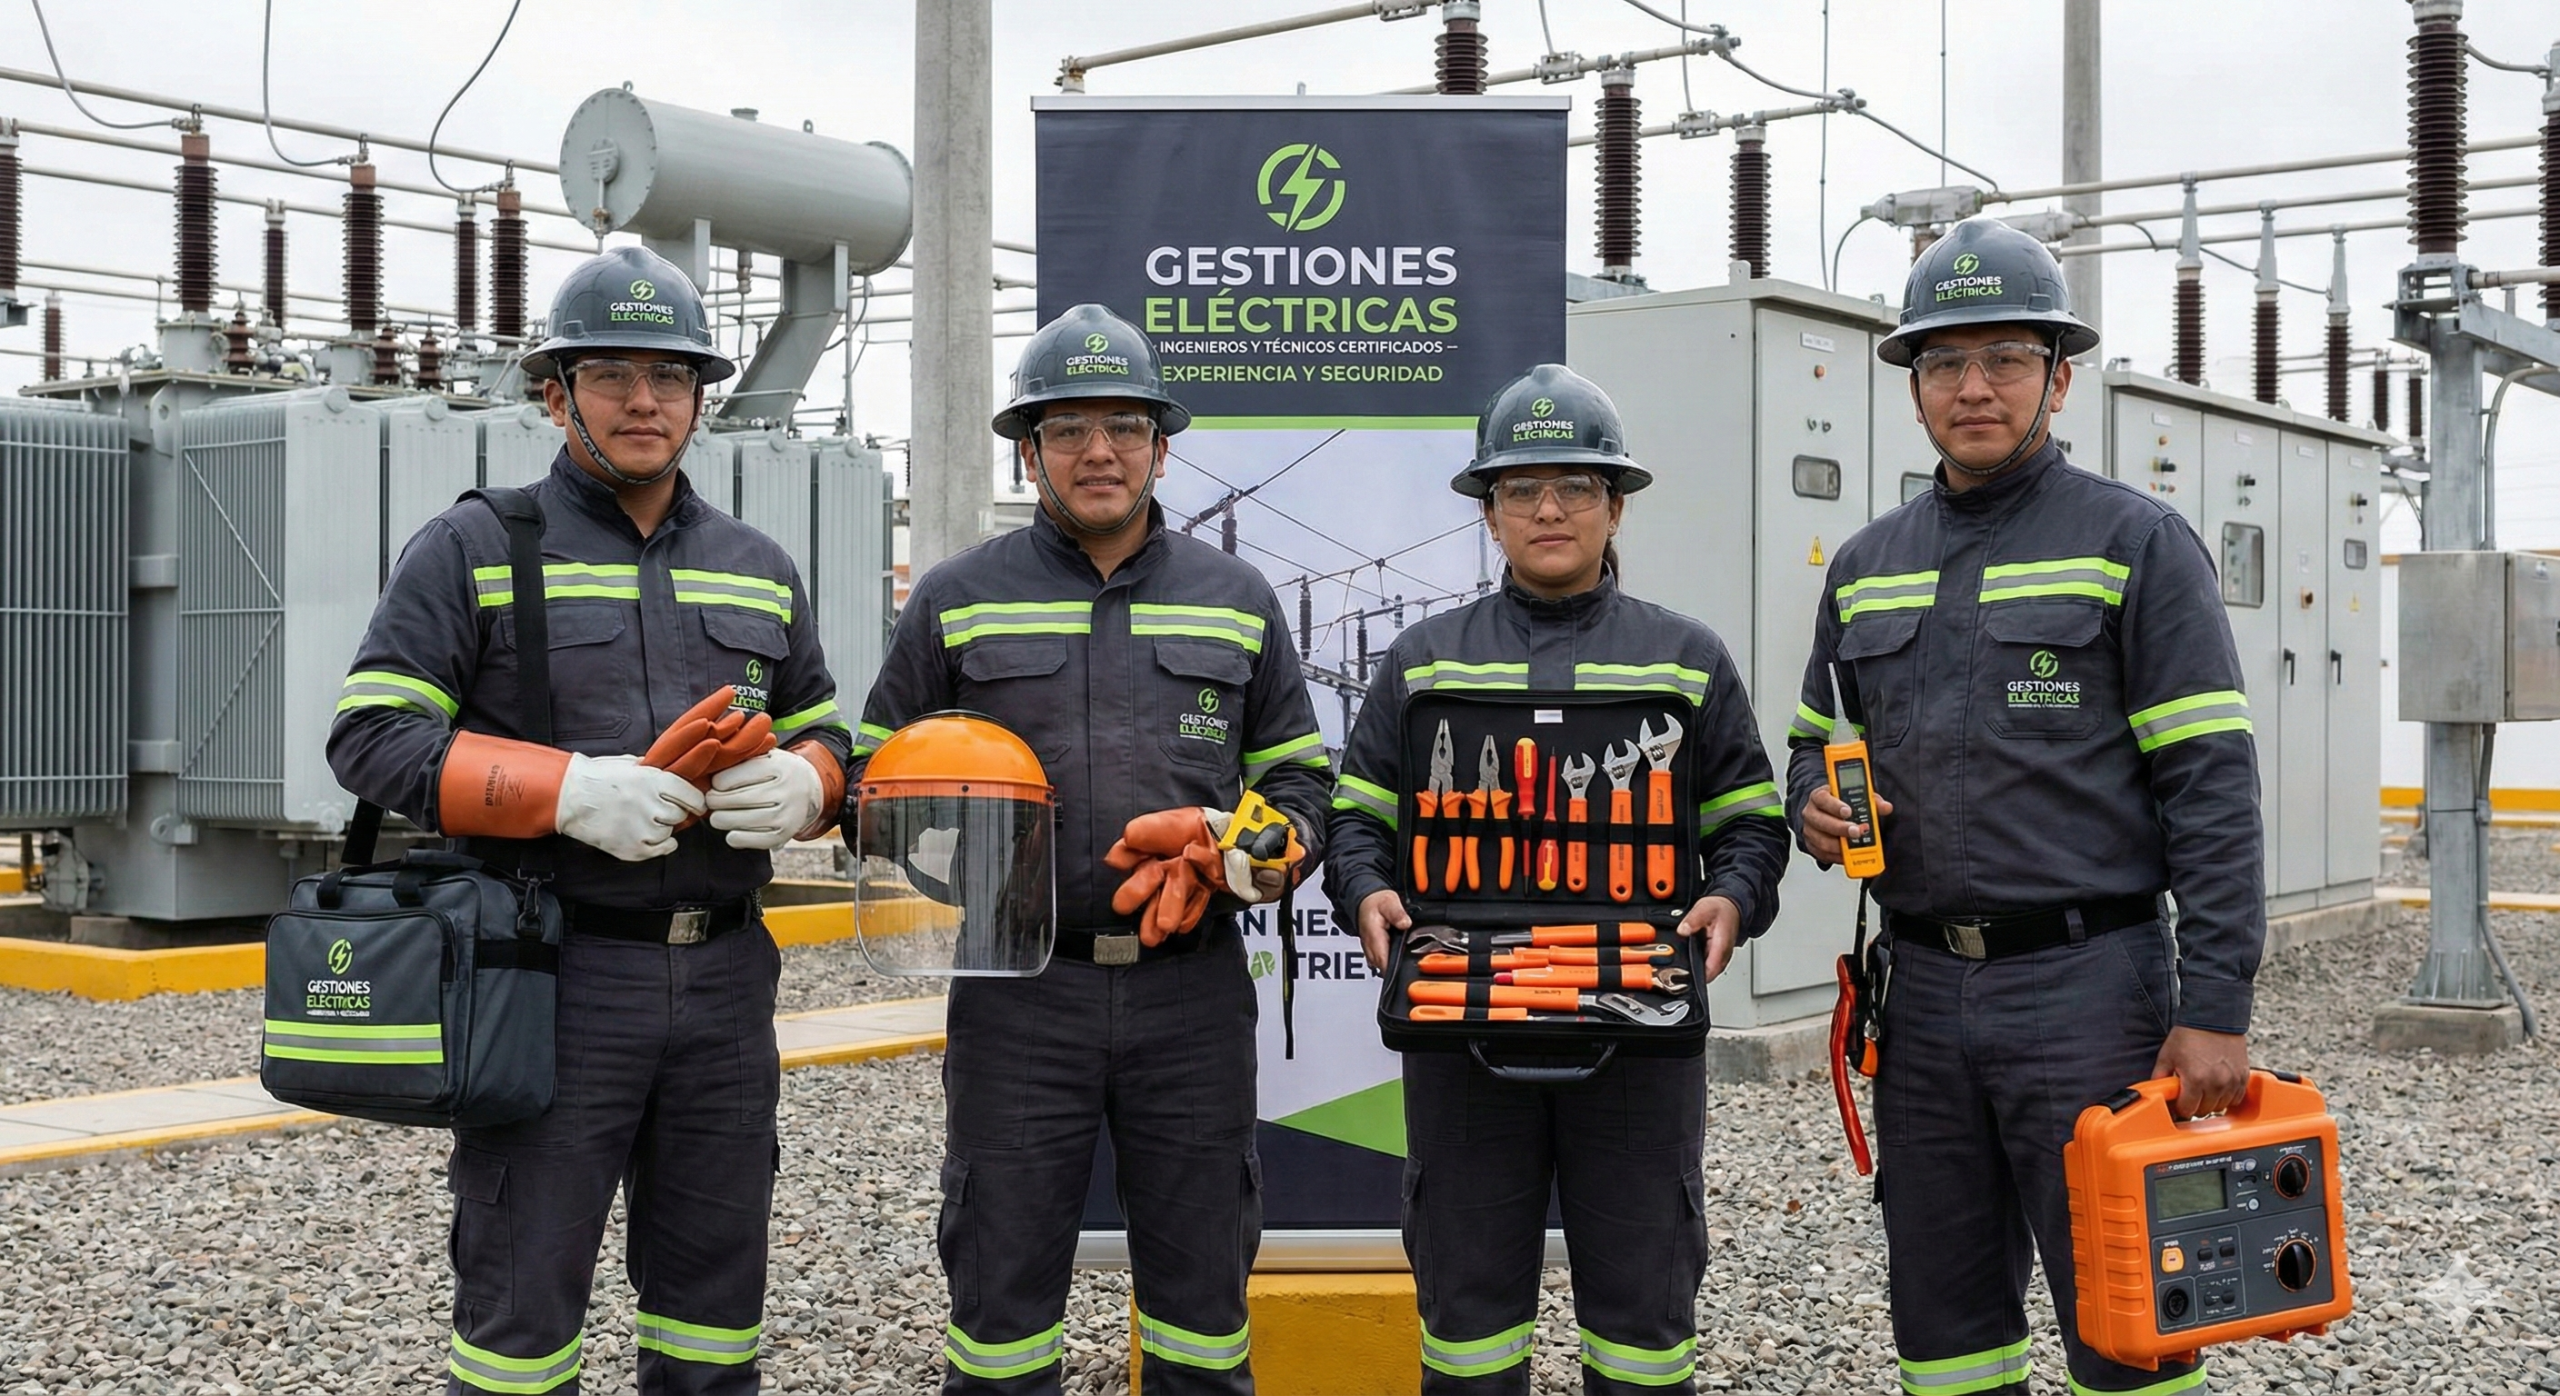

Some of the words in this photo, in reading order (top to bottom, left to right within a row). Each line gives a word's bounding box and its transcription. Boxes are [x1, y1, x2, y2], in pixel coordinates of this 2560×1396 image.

[1145, 246, 1458, 286] GESTIONES
[1935, 276, 2002, 291] GESTIONES
[1145, 287, 1458, 333] ELÉCTRICAS
[1160, 340, 1248, 354] INGENIEROS
[1250, 340, 1261, 354] Y
[1263, 337, 1336, 354] TÉCNICOS
[1338, 340, 1443, 354] CERTIFICADOS
[1162, 365, 1297, 382] EXPERIENCIA
[1302, 365, 1316, 382] Y
[1321, 365, 1443, 382] SEGURIDAD
[2007, 681, 2080, 692] GESTIONES
[307, 980, 371, 994] GESTIONES
